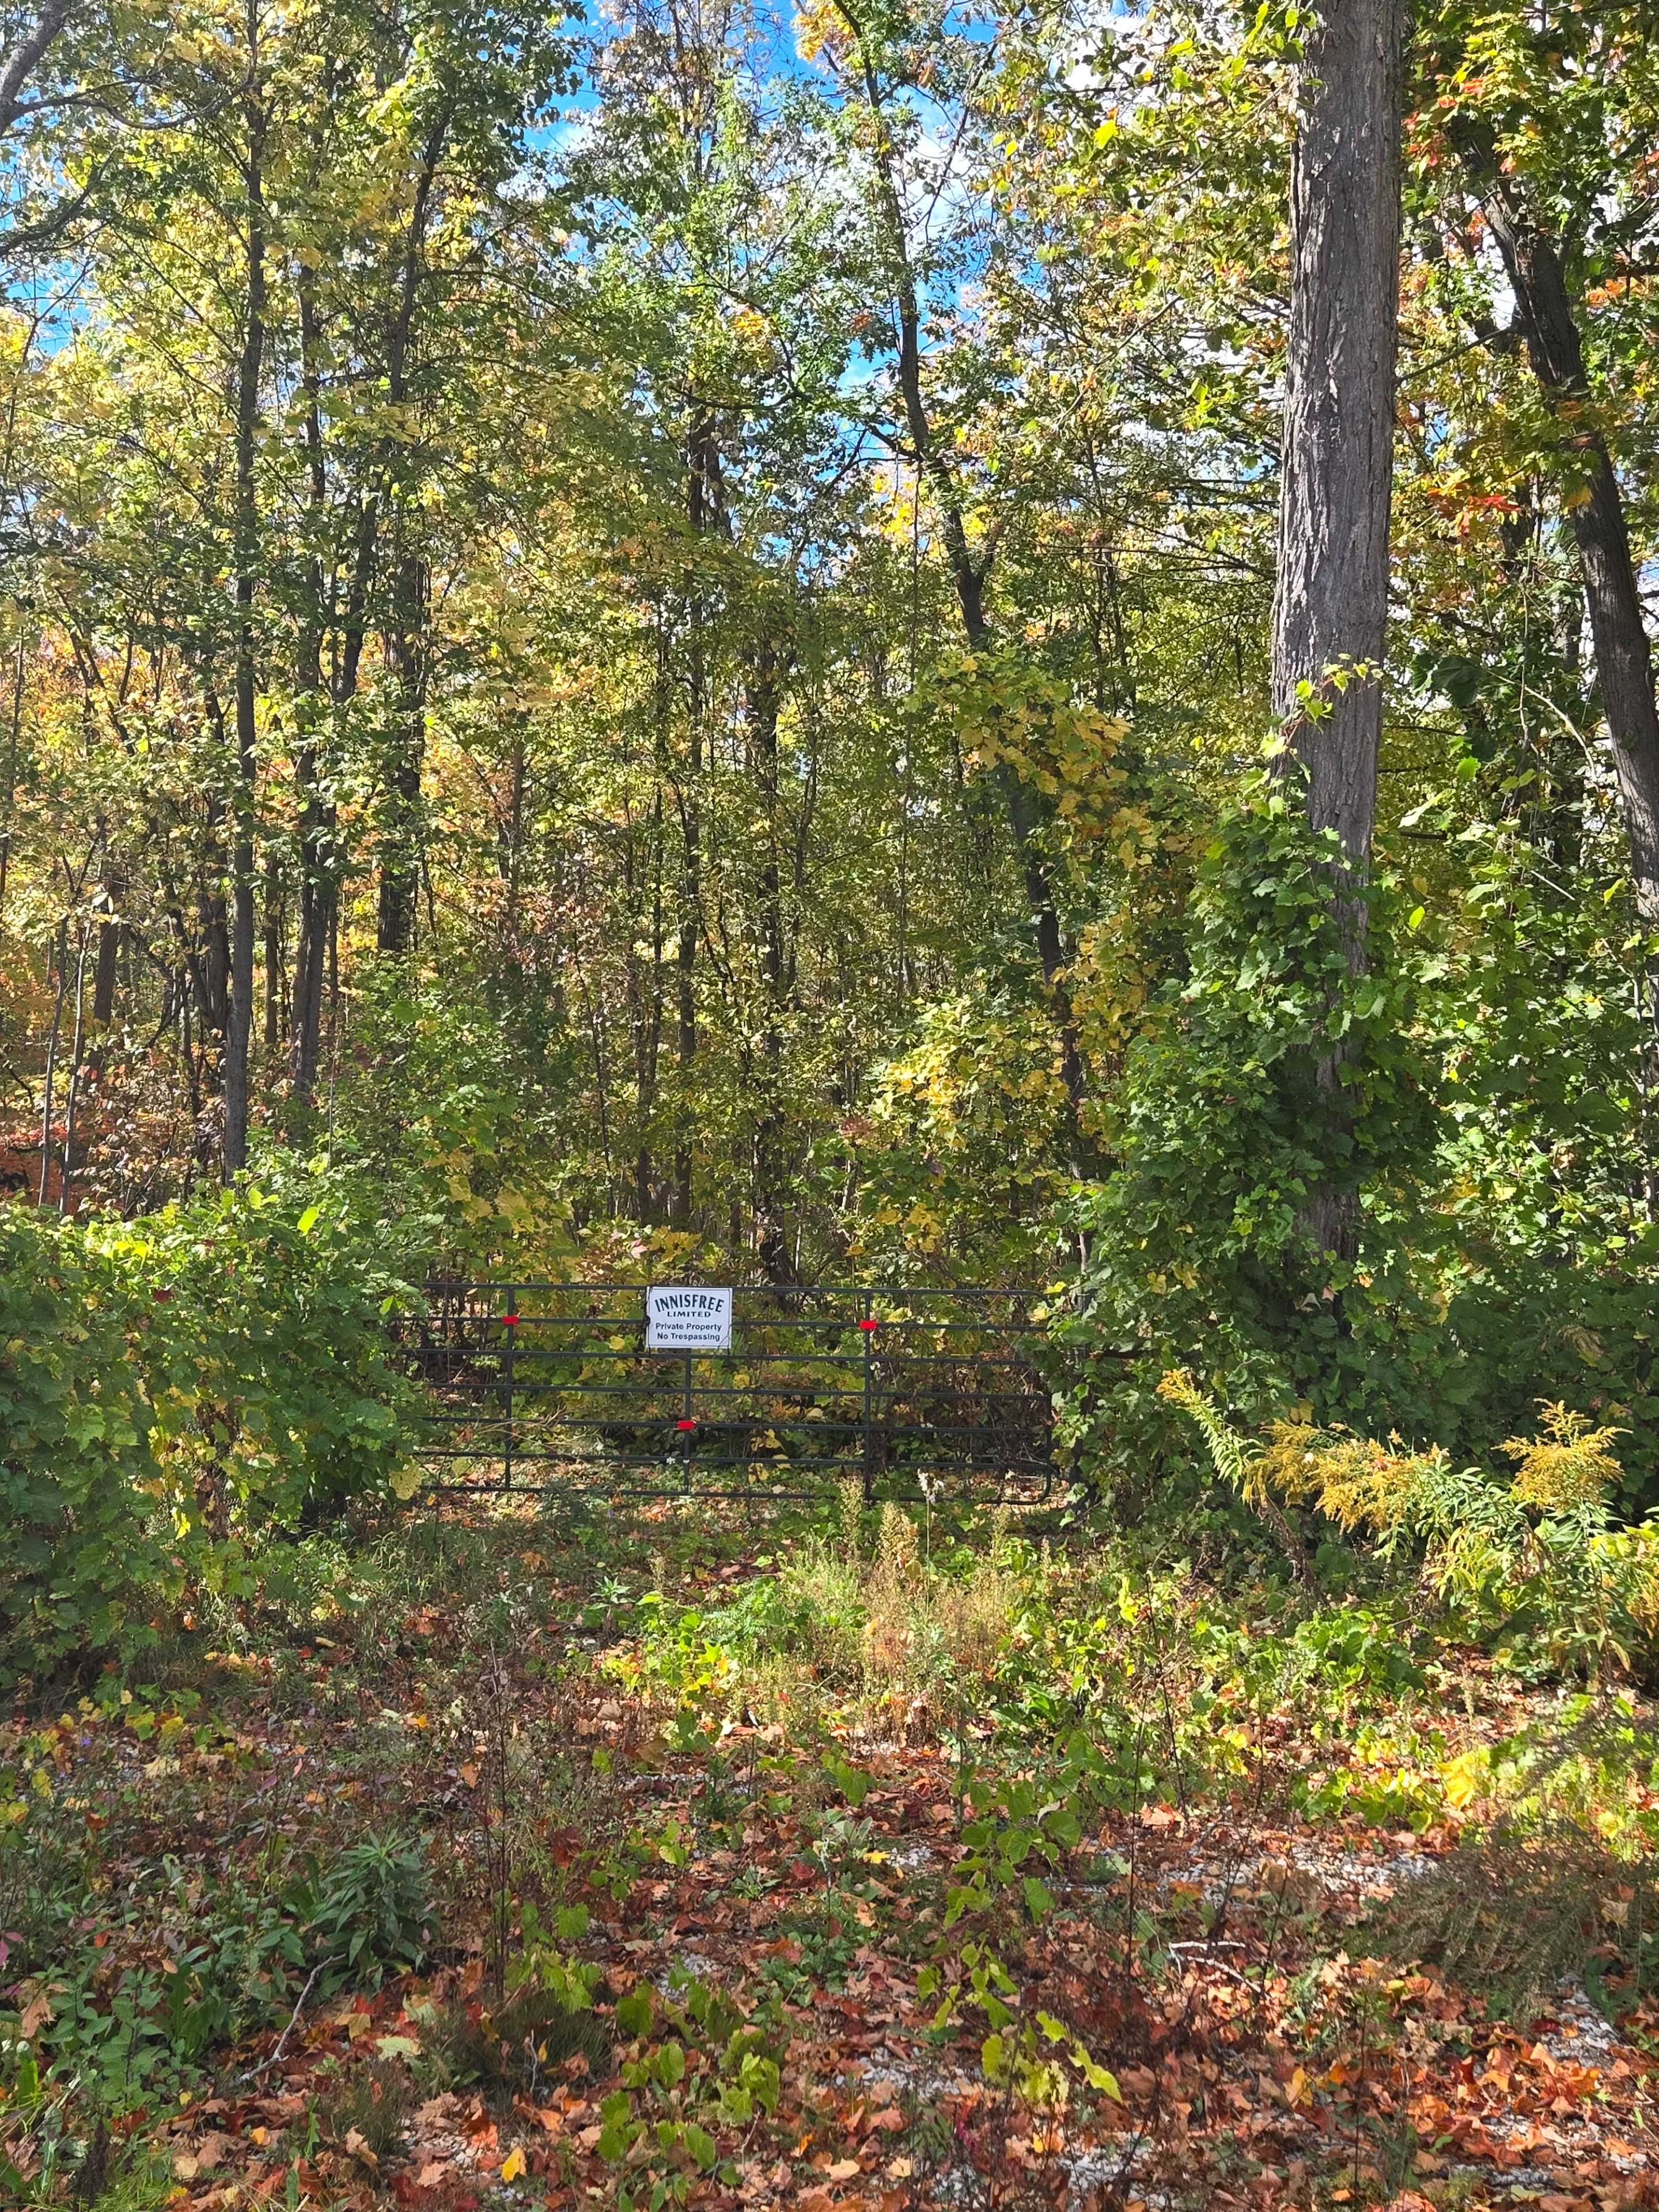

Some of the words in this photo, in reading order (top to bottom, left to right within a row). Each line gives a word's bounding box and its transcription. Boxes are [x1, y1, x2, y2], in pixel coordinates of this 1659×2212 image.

[654, 1294, 724, 1313] INNISFREE
[686, 1323, 722, 1332] Property
[671, 1332, 720, 1342] Trespassing
